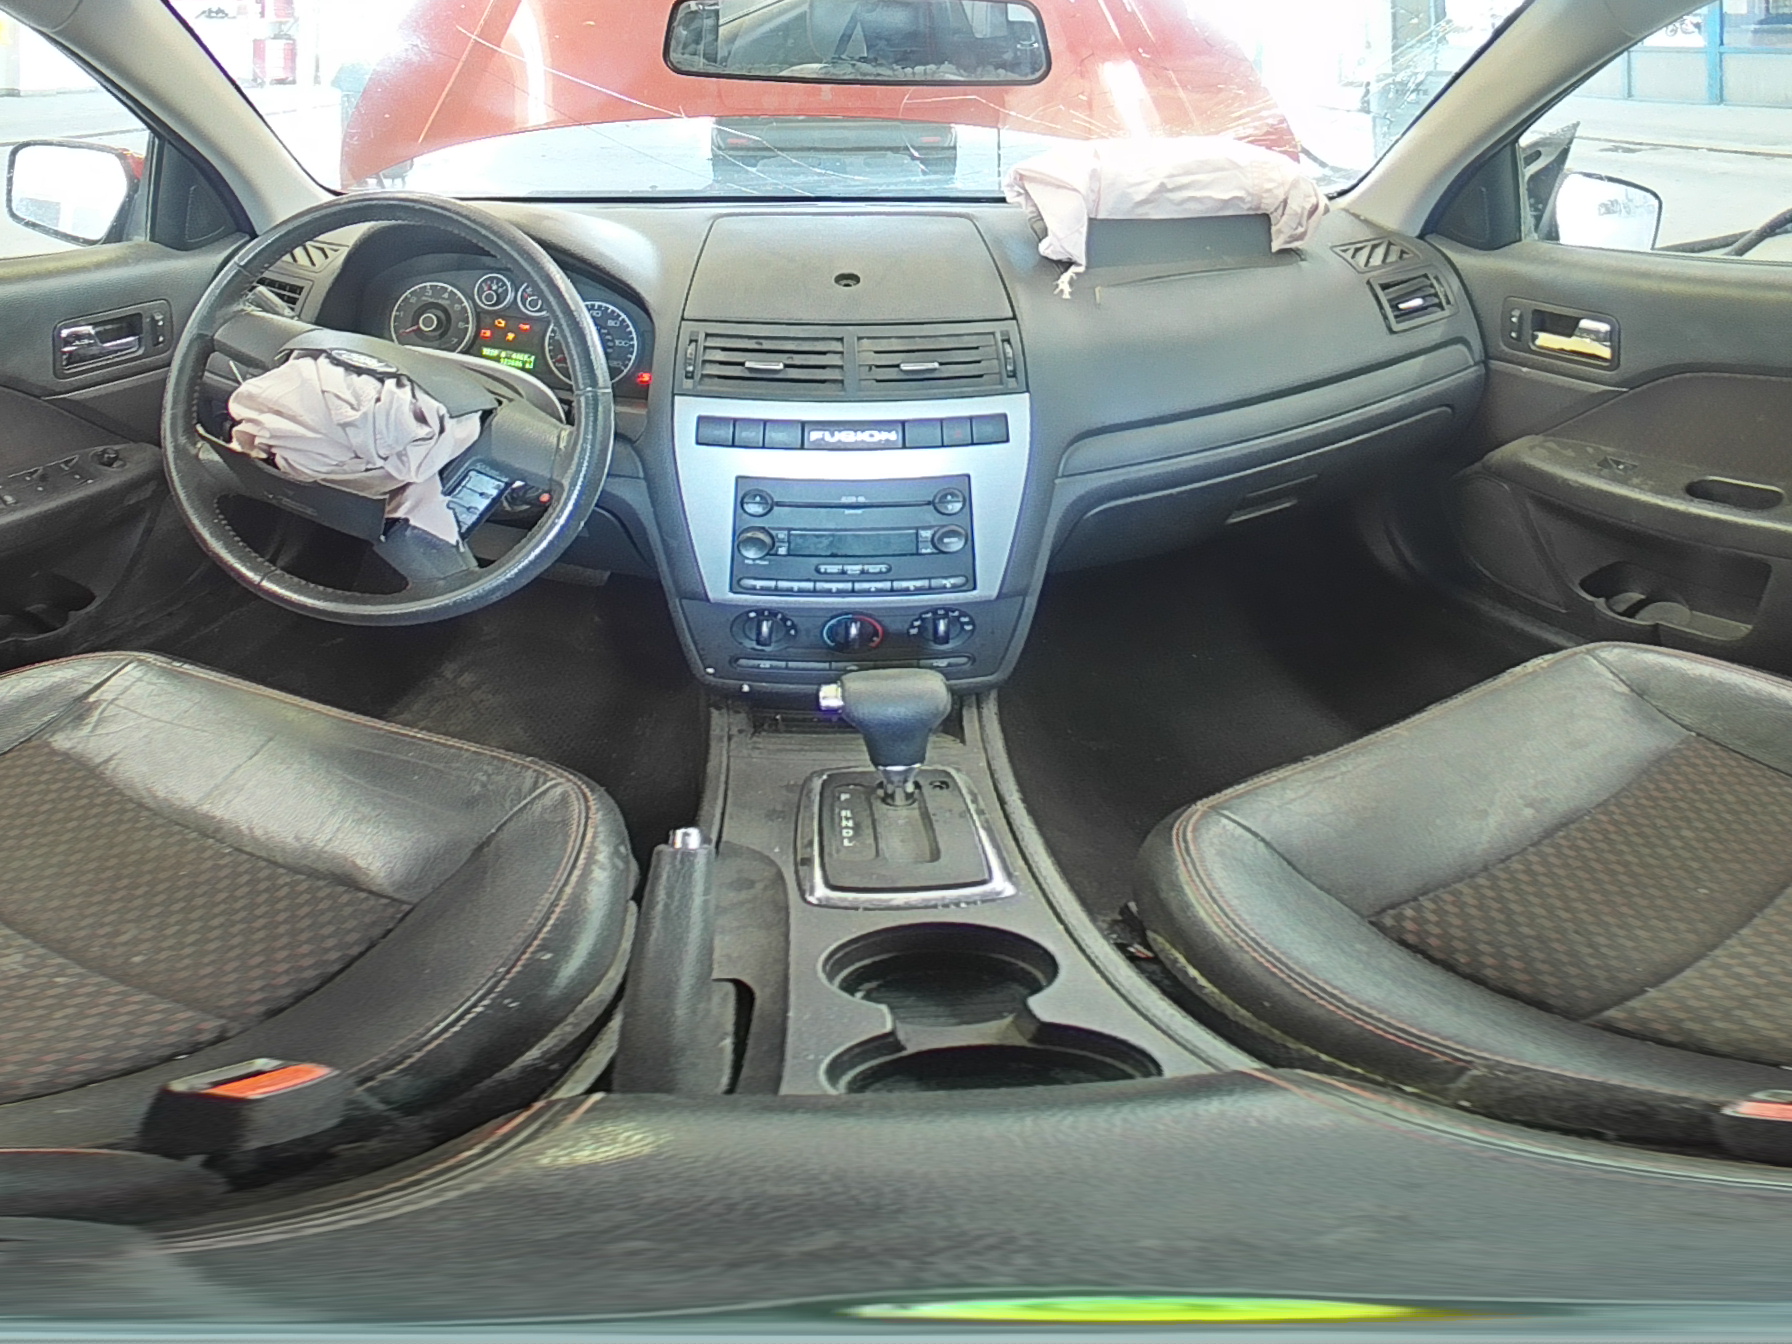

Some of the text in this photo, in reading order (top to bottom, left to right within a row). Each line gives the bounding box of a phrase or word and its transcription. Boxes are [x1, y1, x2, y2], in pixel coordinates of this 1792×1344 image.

[809, 430, 898, 443] FUSION
[840, 793, 851, 801] P
[841, 817, 854, 827] N
[842, 829, 853, 837] D
[843, 838, 856, 846] L
